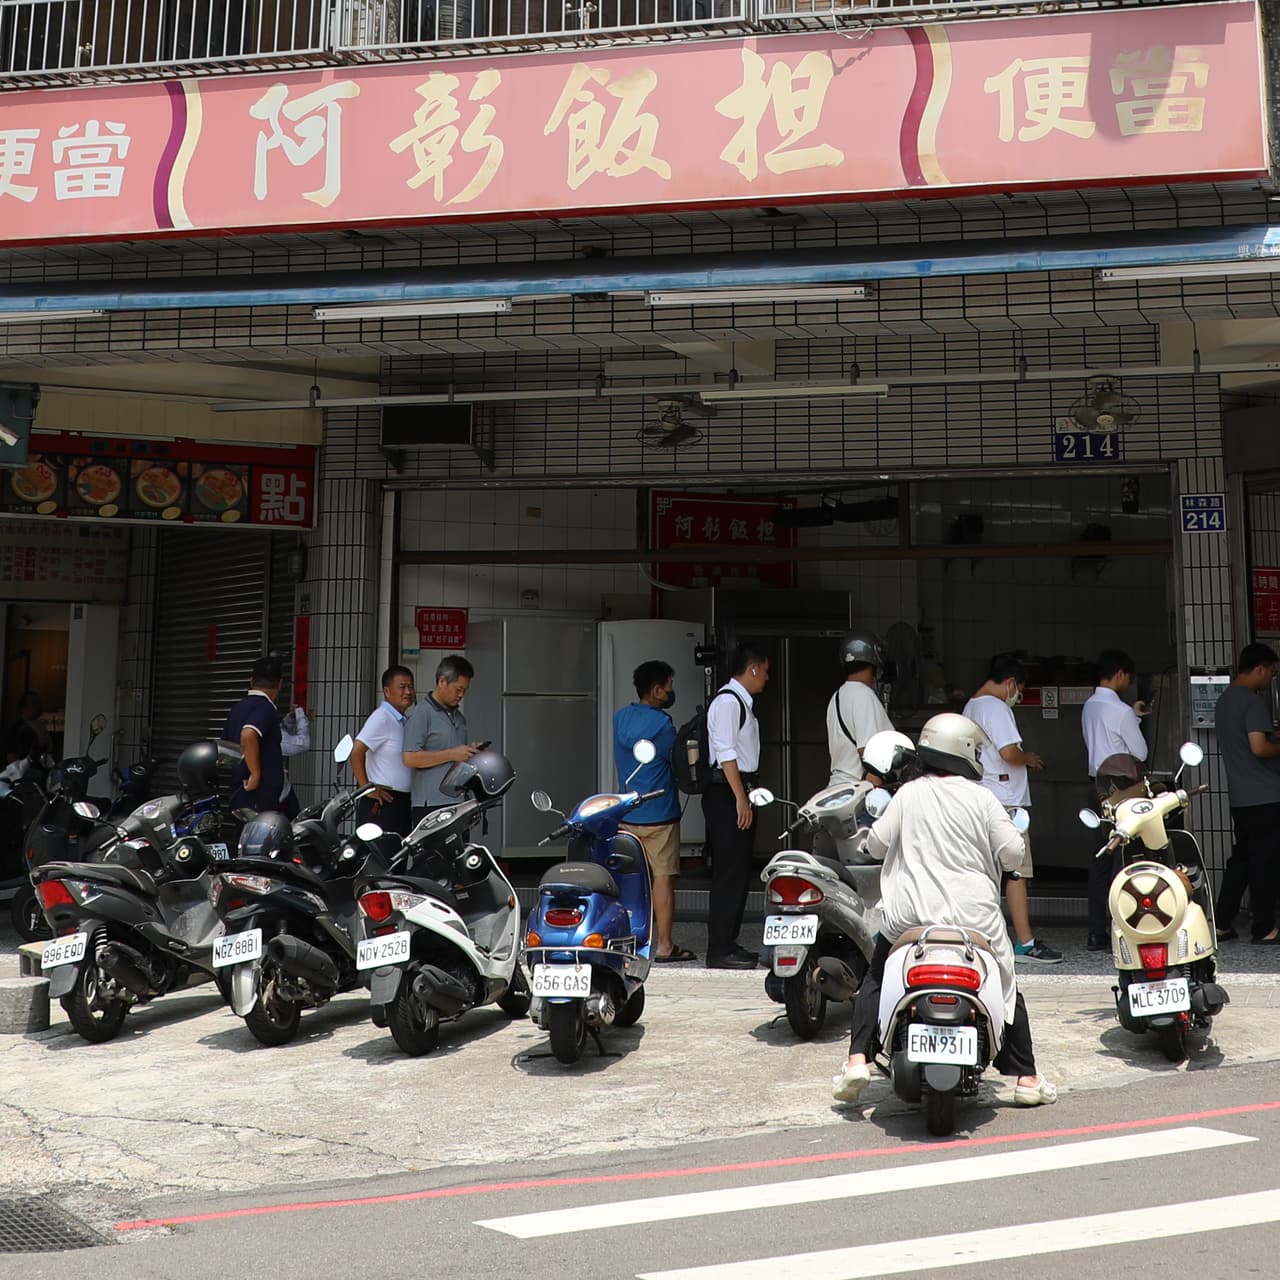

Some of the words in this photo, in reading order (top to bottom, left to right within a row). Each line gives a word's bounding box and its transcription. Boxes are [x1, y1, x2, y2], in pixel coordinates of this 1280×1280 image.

[250, 47, 844, 207] 阿彰飯担
[984, 44, 1210, 143] 便當
[1063, 434, 1114, 458] 214
[260, 473, 307, 521] 點
[1187, 512, 1221, 529] 214
